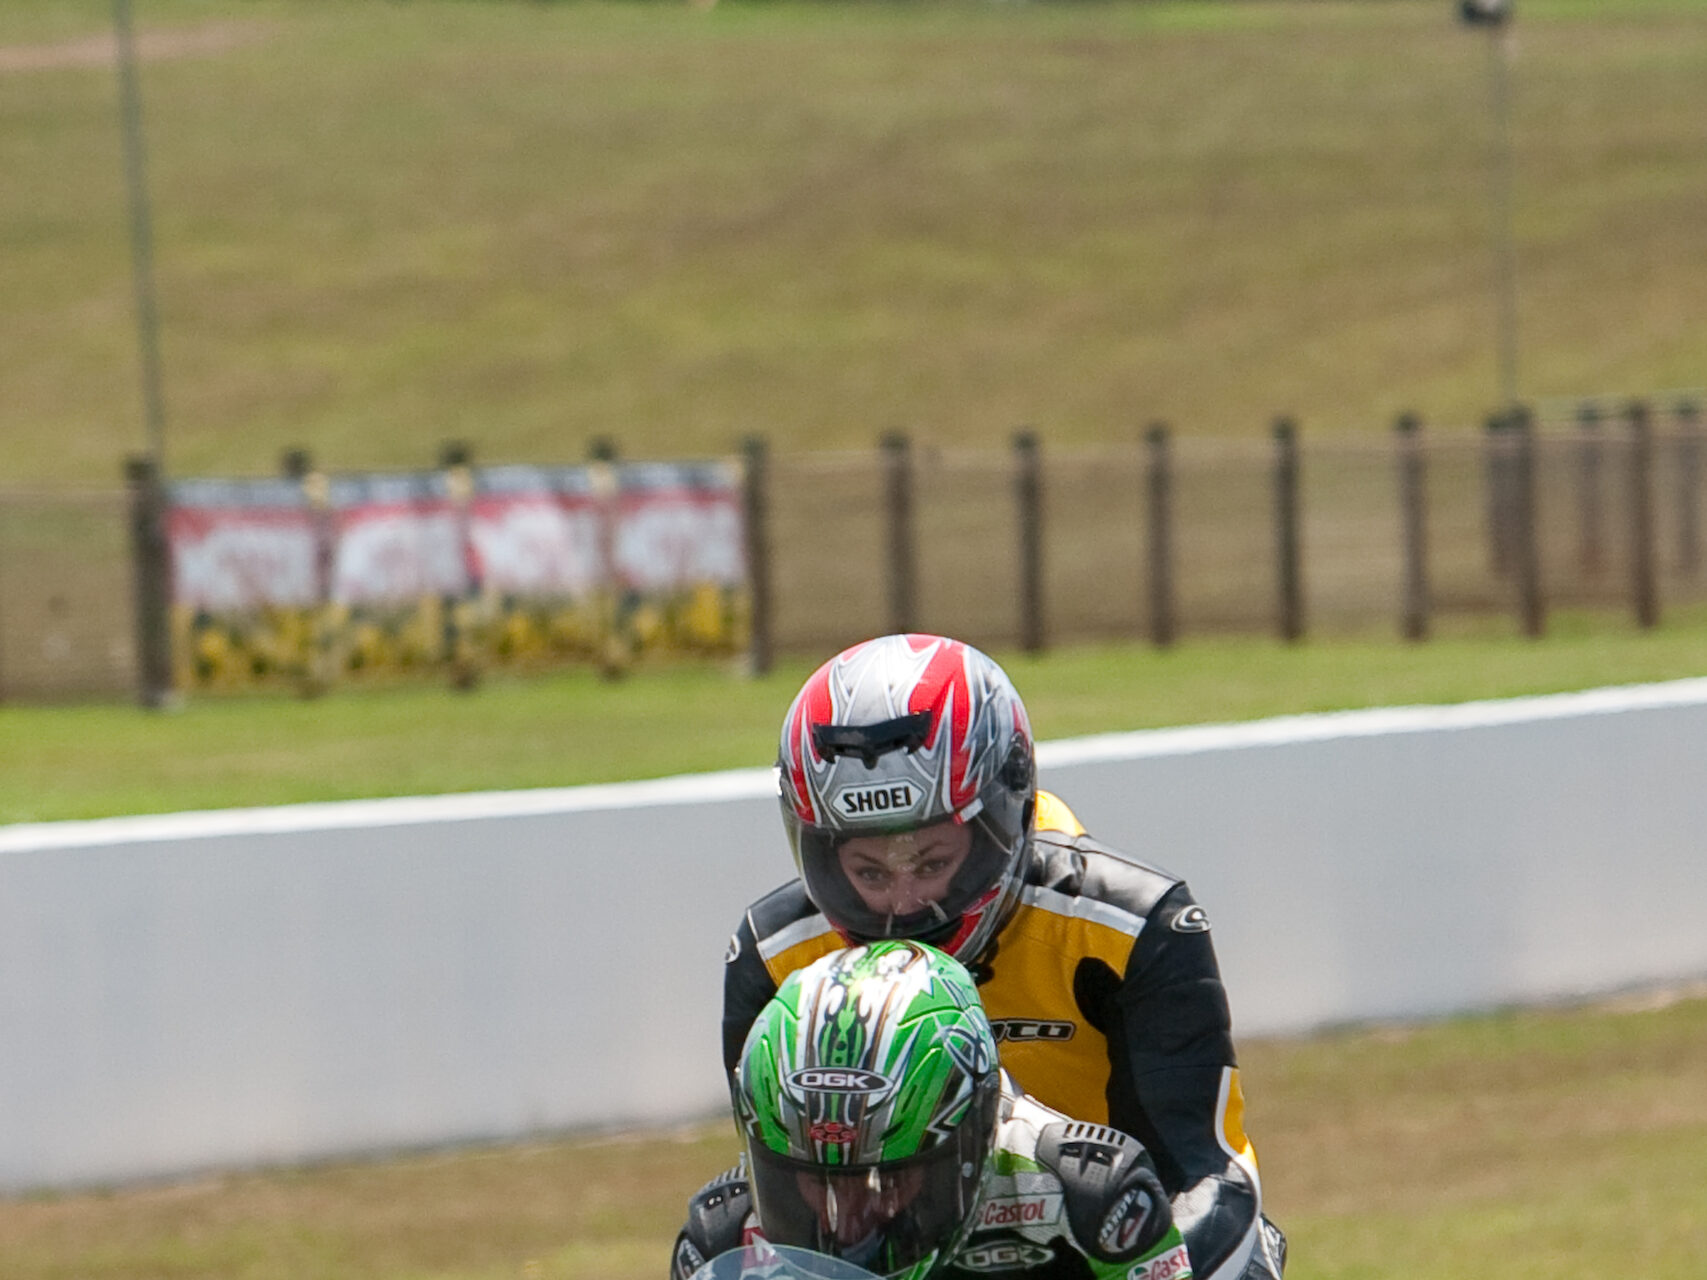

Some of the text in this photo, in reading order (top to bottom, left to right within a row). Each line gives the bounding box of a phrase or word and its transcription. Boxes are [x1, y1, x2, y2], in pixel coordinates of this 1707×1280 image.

[843, 786, 912, 813] SHOEI
[801, 1072, 870, 1089] OGK
[985, 1199, 1046, 1225] Castrol
